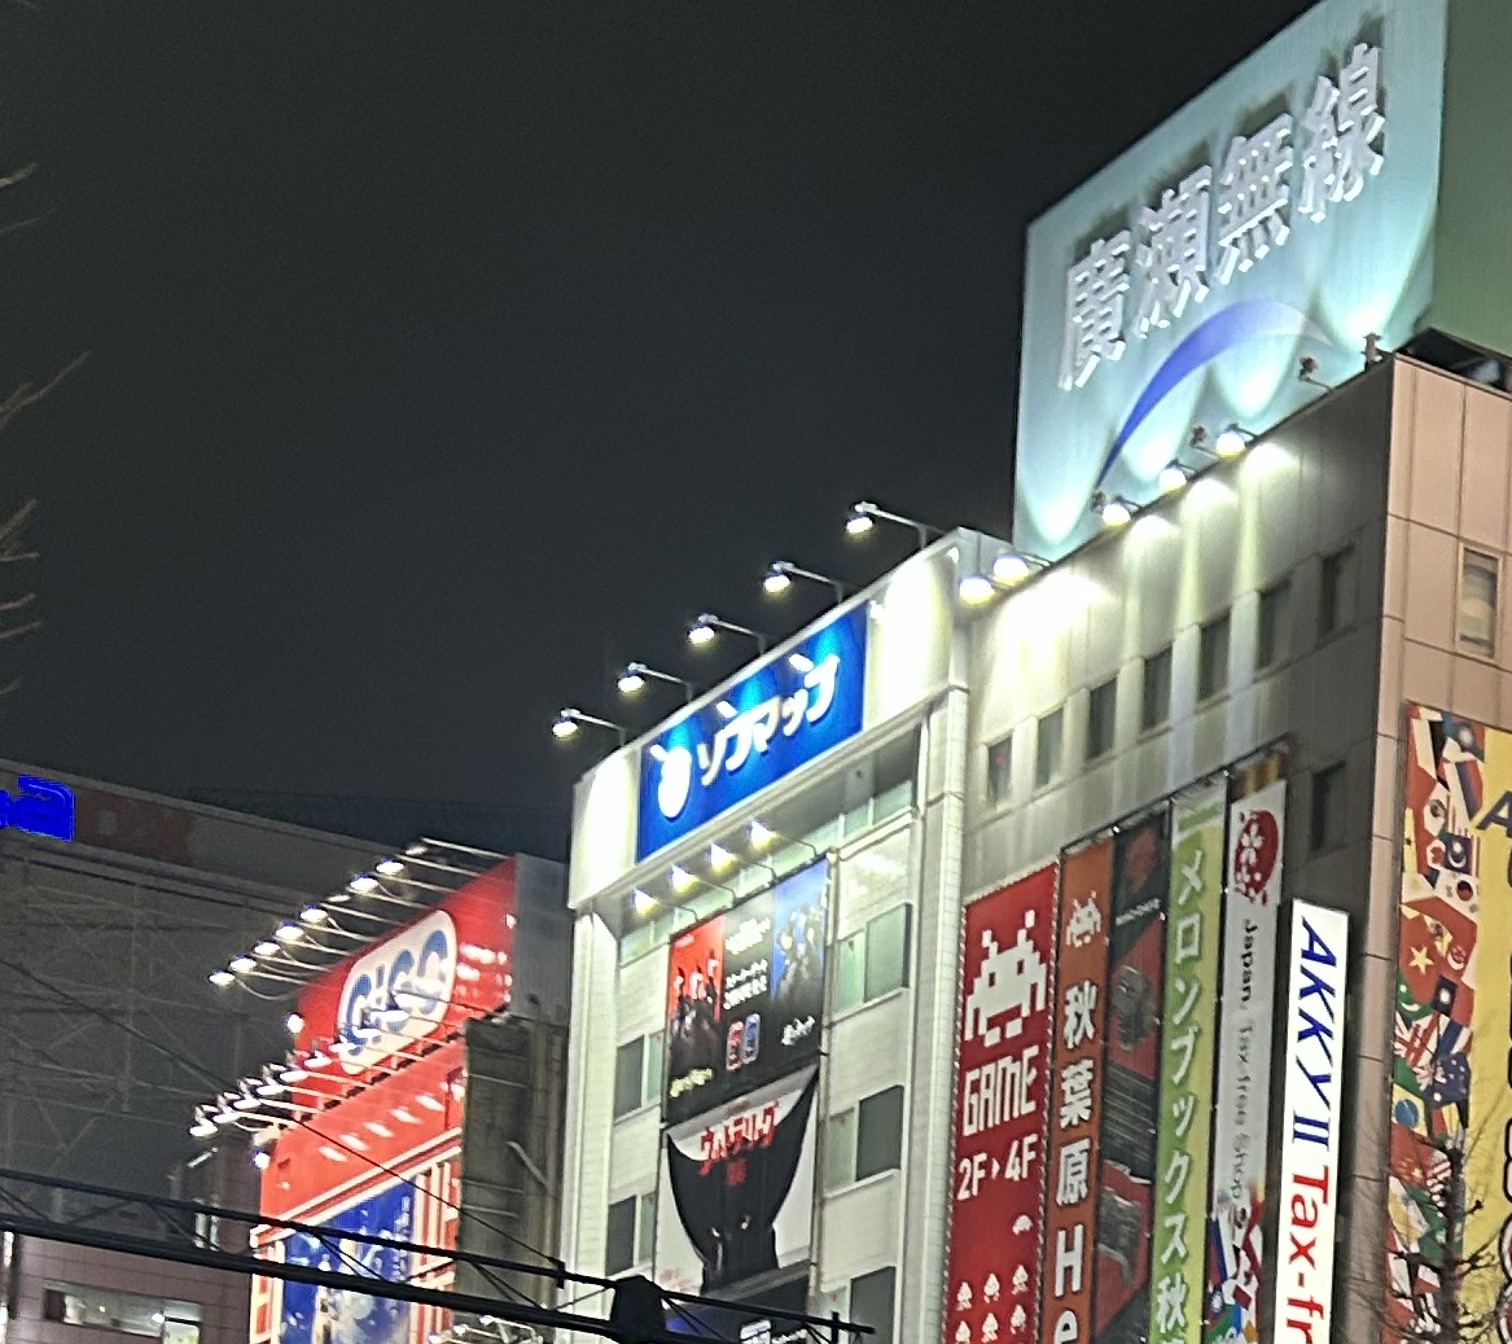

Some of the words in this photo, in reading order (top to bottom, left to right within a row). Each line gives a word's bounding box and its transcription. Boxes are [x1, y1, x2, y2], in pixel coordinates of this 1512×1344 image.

[697, 652, 841, 787] ソフマップ
[1296, 915, 1340, 1112] AKKY
[962, 1043, 1041, 1138] GAME
[956, 1151, 988, 1202] 2F
[1004, 1133, 1039, 1183] 4F
